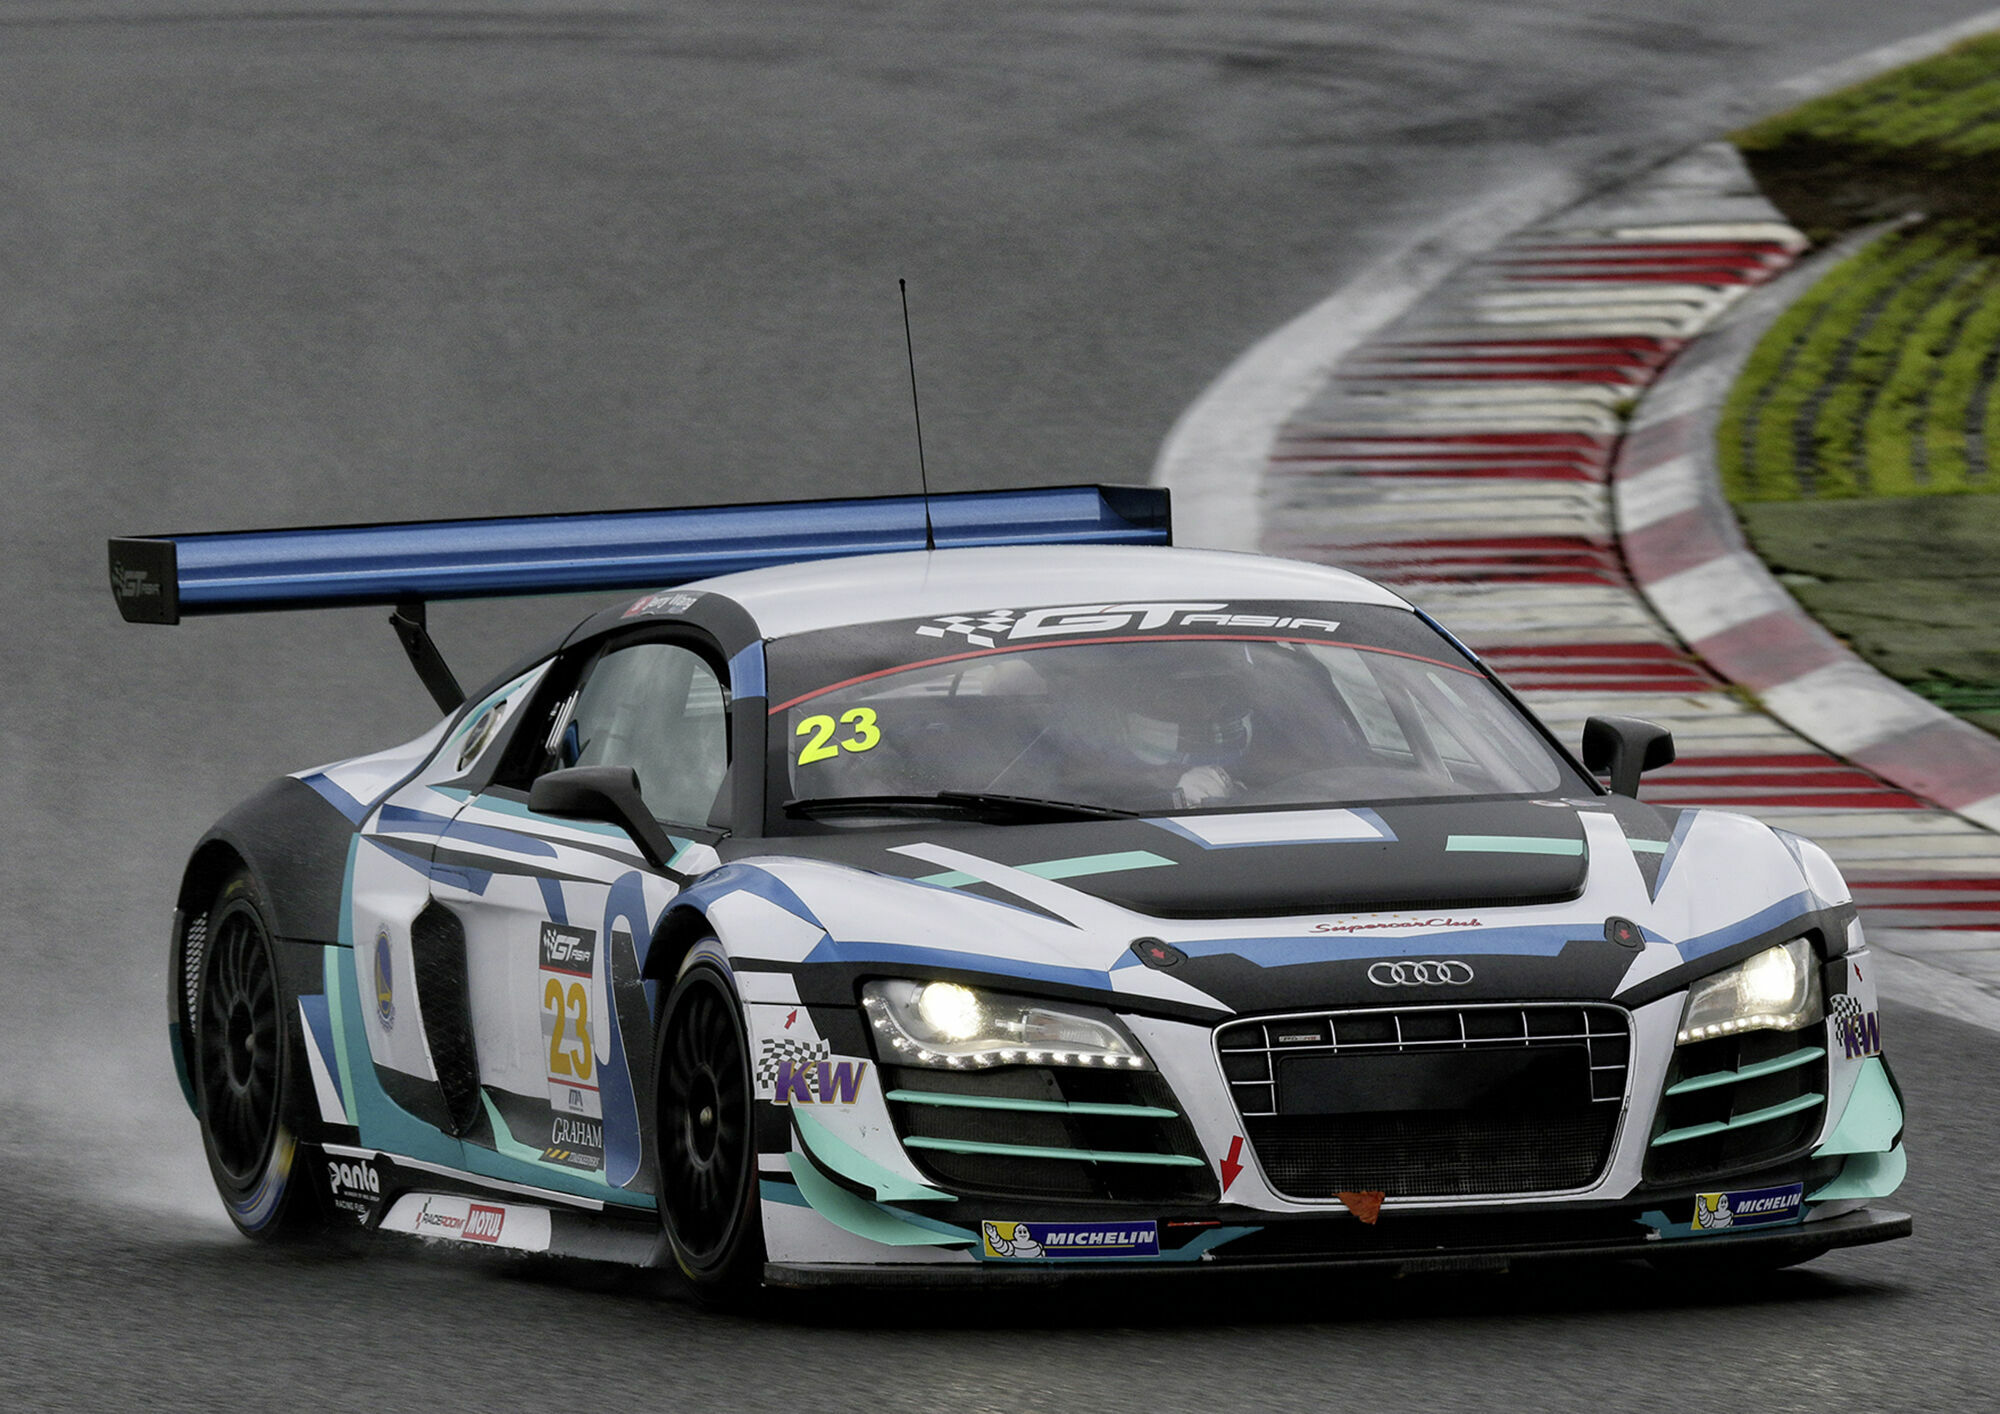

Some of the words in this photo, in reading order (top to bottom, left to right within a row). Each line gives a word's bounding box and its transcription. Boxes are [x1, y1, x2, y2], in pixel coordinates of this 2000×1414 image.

[1008, 603, 1229, 640] GT
[1180, 613, 1341, 633] ASIA
[796, 707, 881, 767] 23
[552, 933, 581, 962] GT
[544, 977, 593, 1081] 23
[775, 1061, 867, 1105] KW
[552, 1117, 603, 1149] GRAHAM
[1736, 1192, 1802, 1214] MICHELIN
[465, 1210, 502, 1238] MOTUL
[1045, 1230, 1155, 1246] MICHELIN
